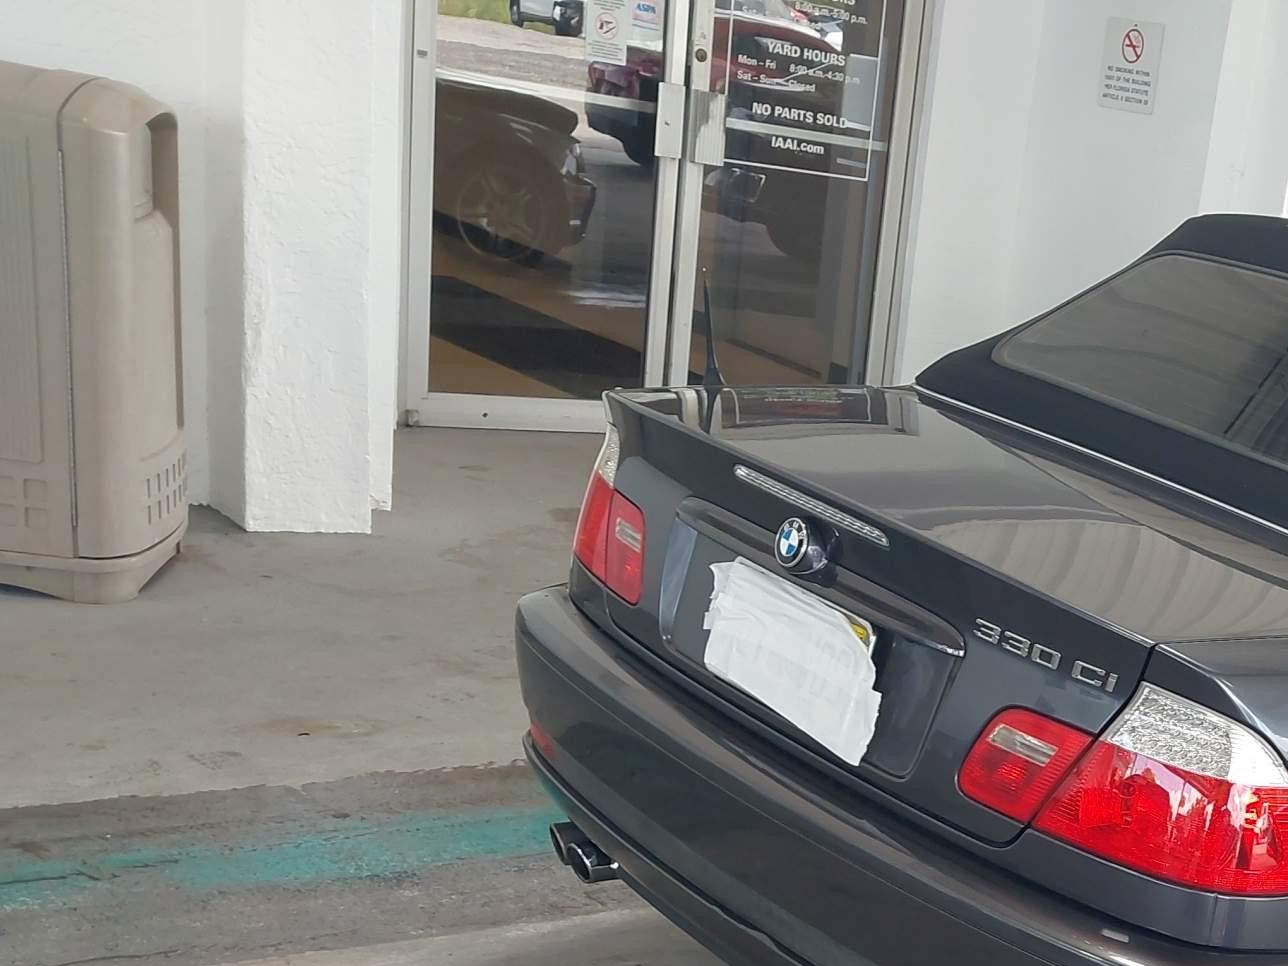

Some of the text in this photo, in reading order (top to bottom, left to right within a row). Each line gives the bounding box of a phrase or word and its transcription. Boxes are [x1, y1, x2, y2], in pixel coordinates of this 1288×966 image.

[850, 15, 868, 25] p.m.
[738, 54, 758, 67] Mon
[765, 59, 777, 70] Fri
[789, 63, 808, 76] 8:00
[768, 40, 846, 67] YARD HOURS
[737, 70, 753, 82] Sat
[788, 79, 816, 93] Closed
[752, 102, 848, 129] NO PARTS SOLD
[771, 136, 825, 155] IAAI.com
[972, 617, 1062, 671] 330
